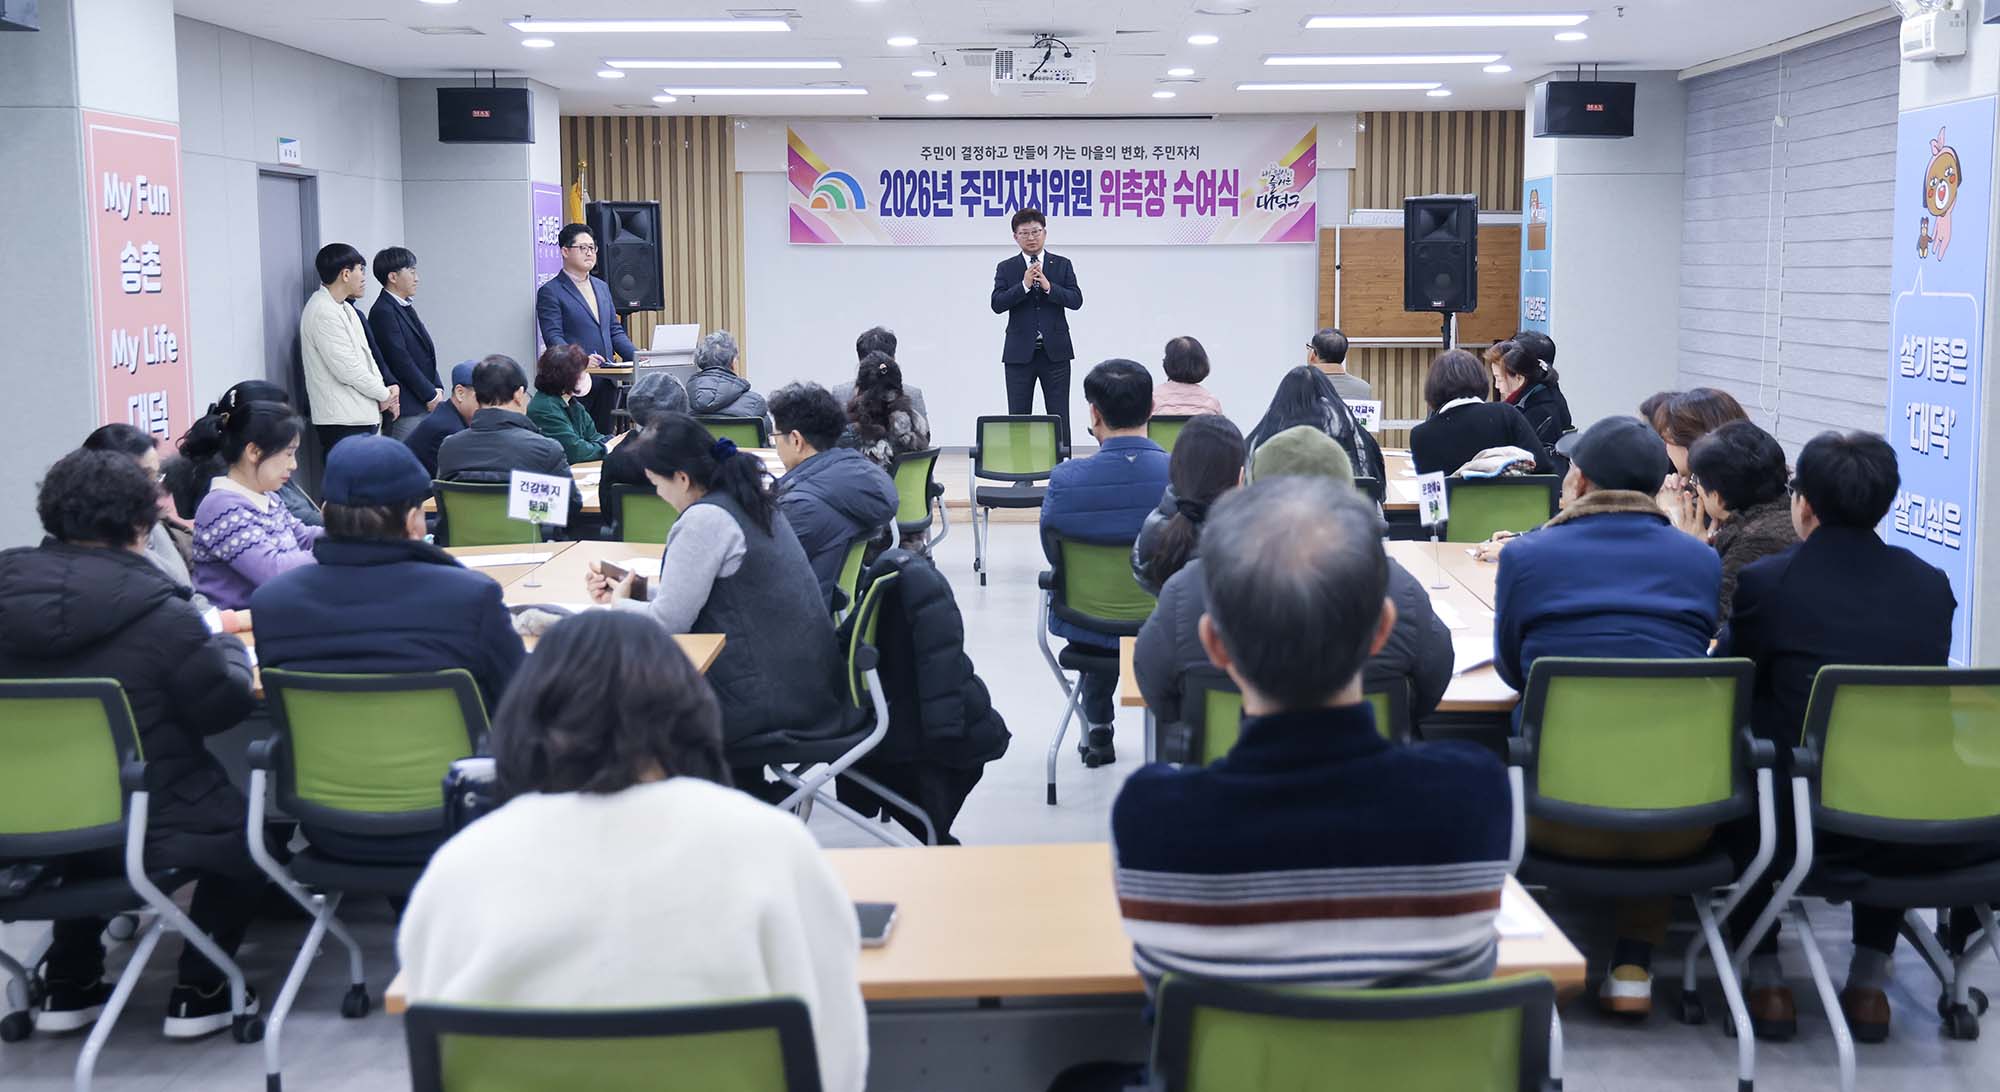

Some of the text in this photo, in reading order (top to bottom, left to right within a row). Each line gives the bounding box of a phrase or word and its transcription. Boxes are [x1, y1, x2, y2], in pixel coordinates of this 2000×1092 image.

[920, 145, 1200, 161] 주민이 결정하고 만들어 가는 마을의 변화, 주민자치
[103, 171, 171, 221] My Fun
[880, 168, 1240, 217] 2026년 주민자치위원 위촉장 수여식
[1256, 193, 1300, 211] 대덕구
[121, 240, 162, 294] 송촌
[112, 323, 178, 375] My Life
[1900, 334, 1968, 385] 살기좋은
[128, 390, 169, 440] 대덕
[520, 480, 561, 497] 건강복지
[1895, 488, 1962, 551] 살고싶은
